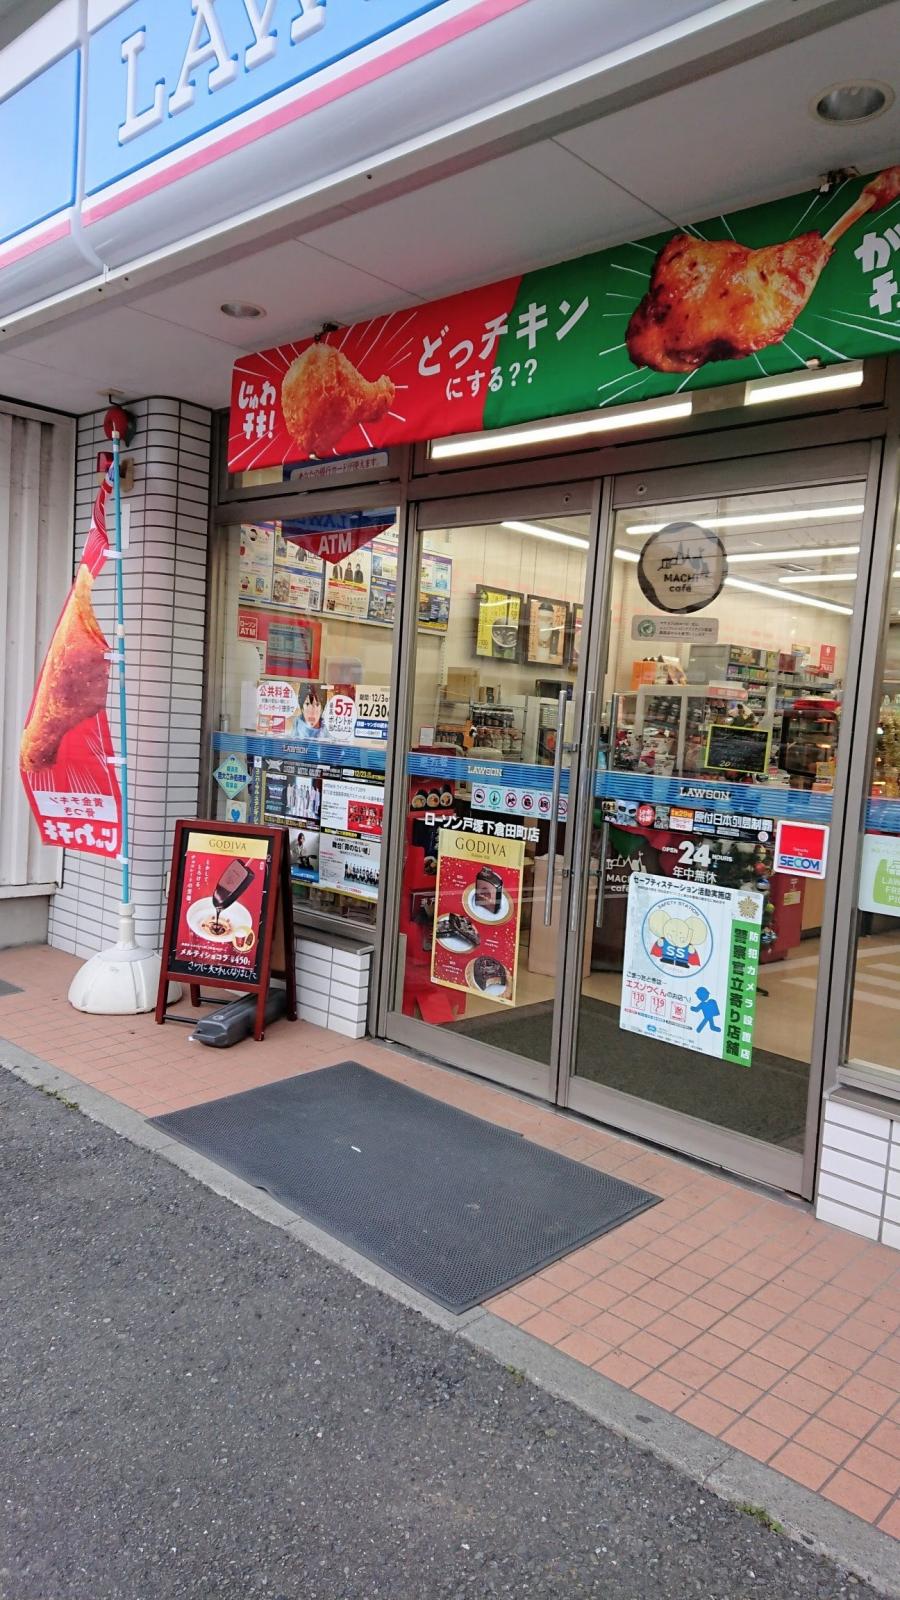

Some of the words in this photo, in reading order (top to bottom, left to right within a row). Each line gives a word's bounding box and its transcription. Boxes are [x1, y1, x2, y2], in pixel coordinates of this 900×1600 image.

[417, 296, 590, 377] どっチキン
[238, 379, 277, 410] じゅわ
[243, 410, 276, 441] チキ!
[318, 532, 352, 556] ATM
[664, 572, 700, 584] MACHI
[240, 628, 257, 637] ATM
[335, 698, 353, 718] 5万
[358, 703, 384, 718] 12/30
[467, 766, 503, 777] LAWSON
[679, 787, 731, 801] LAWSON
[424, 812, 540, 843] ローソン戸塚下倉田町店
[208, 838, 247, 850] GODIVA
[455, 837, 507, 858] GODIVA
[678, 840, 711, 868] 24
[711, 854, 733, 863] HOURS
[780, 856, 820, 871] SECOM
[606, 873, 630, 885] MAC
[673, 866, 717, 884] 年中無休
[633, 875, 733, 902] セーフティステーション活動実施店
[657, 901, 677, 910] SAFETY
[677, 901, 701, 917] STATION
[180, 949, 228, 962] メルティショコラ
[667, 948, 685, 959] SS
[633, 992, 644, 1002] 110
[653, 997, 665, 1007] 119
[726, 927, 748, 1057] 警察官立寄り店舗
[741, 931, 760, 1062] 防犯カメラ設置店
